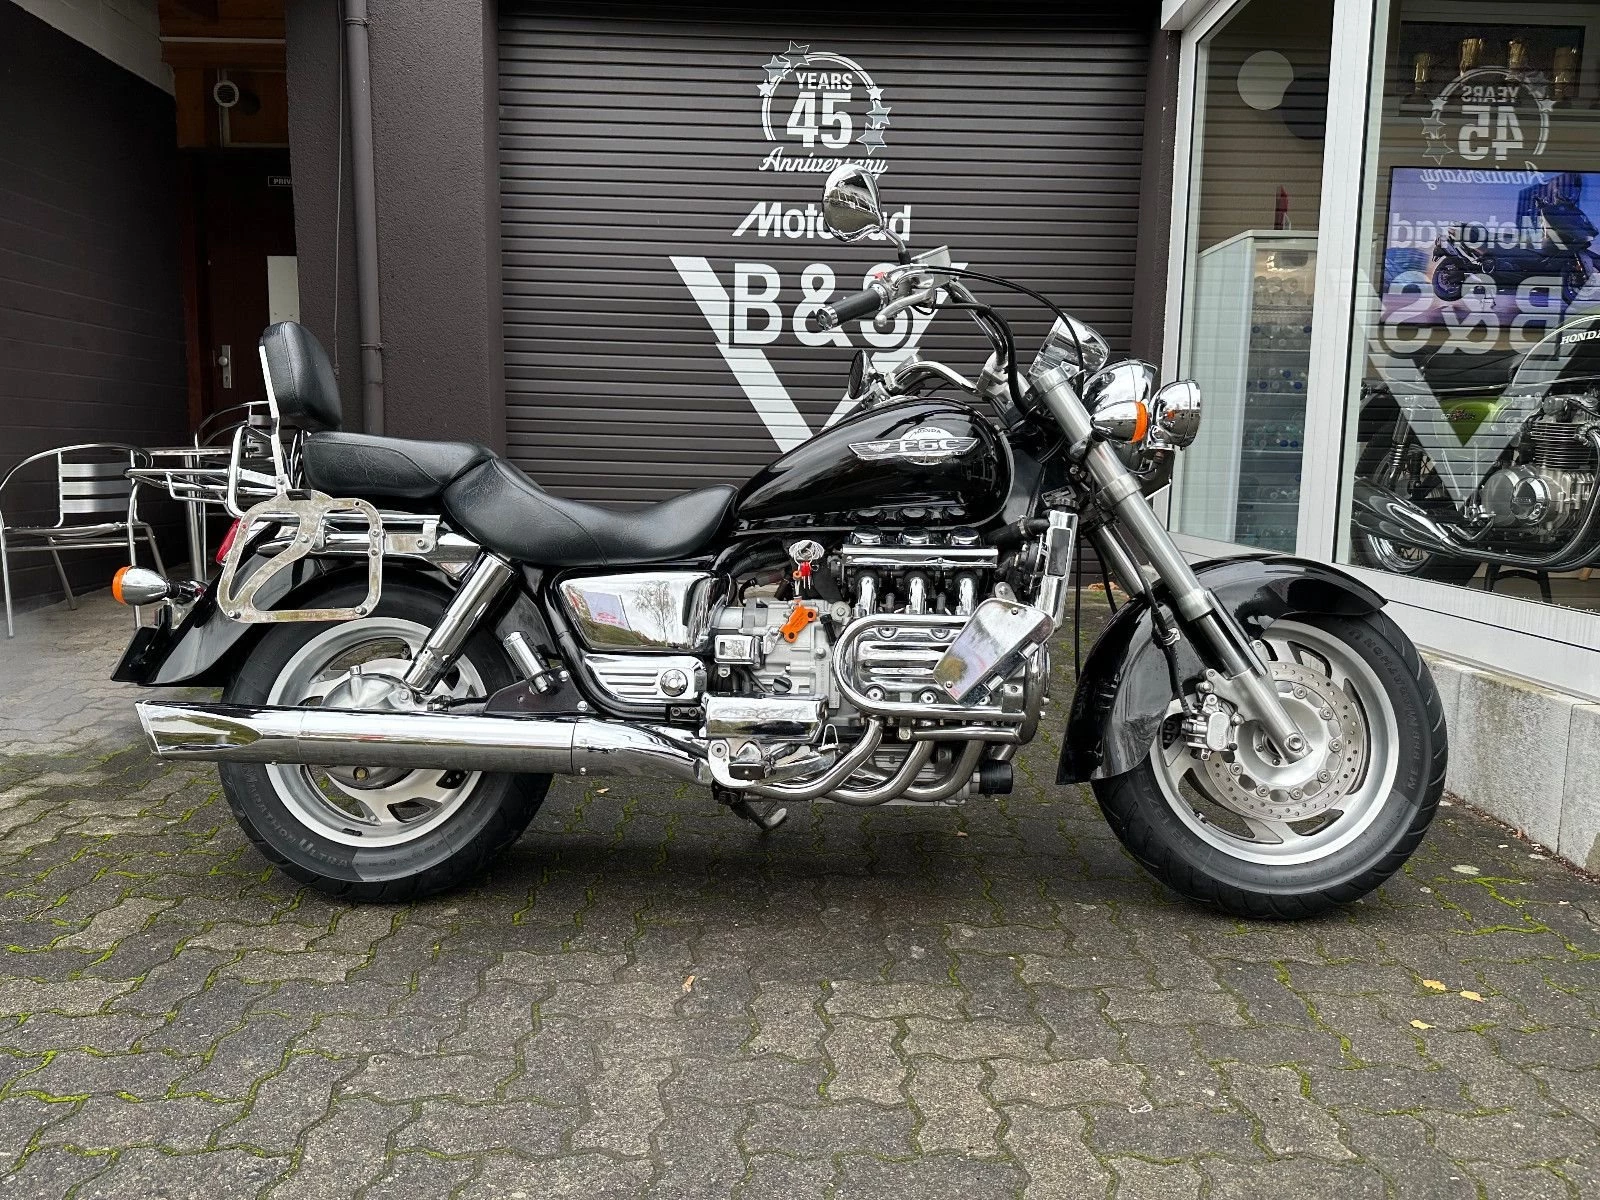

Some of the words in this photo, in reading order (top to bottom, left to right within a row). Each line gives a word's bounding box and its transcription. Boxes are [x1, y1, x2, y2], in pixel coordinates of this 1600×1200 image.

[795, 72, 853, 91] YEARS
[786, 91, 853, 149] 45
[758, 146, 889, 181] Anniverry
[731, 201, 912, 242] Motod
[899, 439, 961, 452] F6C
